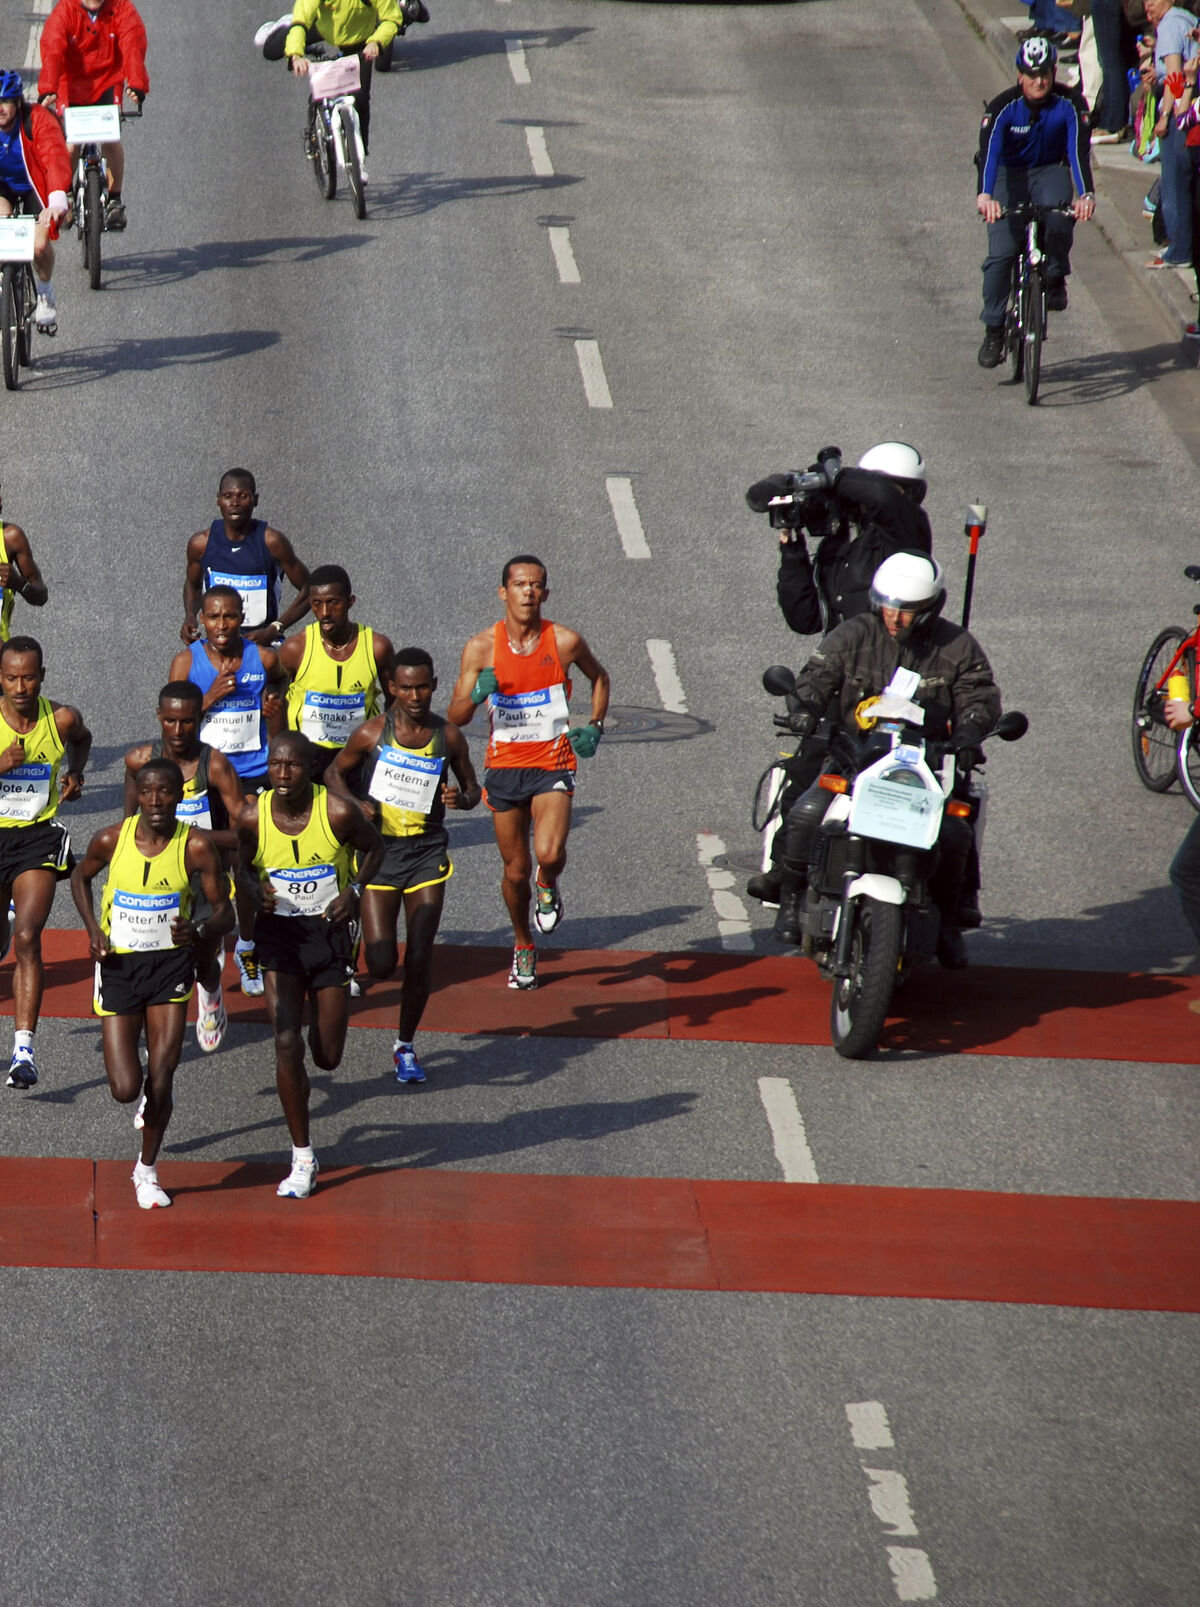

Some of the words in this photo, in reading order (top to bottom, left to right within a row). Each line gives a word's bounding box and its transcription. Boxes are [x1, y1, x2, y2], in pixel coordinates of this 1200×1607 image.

[213, 577, 262, 588] CONERGY
[311, 694, 361, 706] CONERGY
[497, 692, 546, 706] CONERGY
[205, 714, 243, 724] Samuel
[311, 710, 347, 722] Asnake
[498, 709, 531, 721] Paulo
[386, 751, 437, 771] CONERGY
[384, 768, 430, 788] Ketema
[26, 784, 39, 794] A.
[288, 881, 318, 895] 80
[118, 894, 175, 908] CONERGY
[294, 893, 314, 901] Paul
[120, 911, 154, 925] Peter
